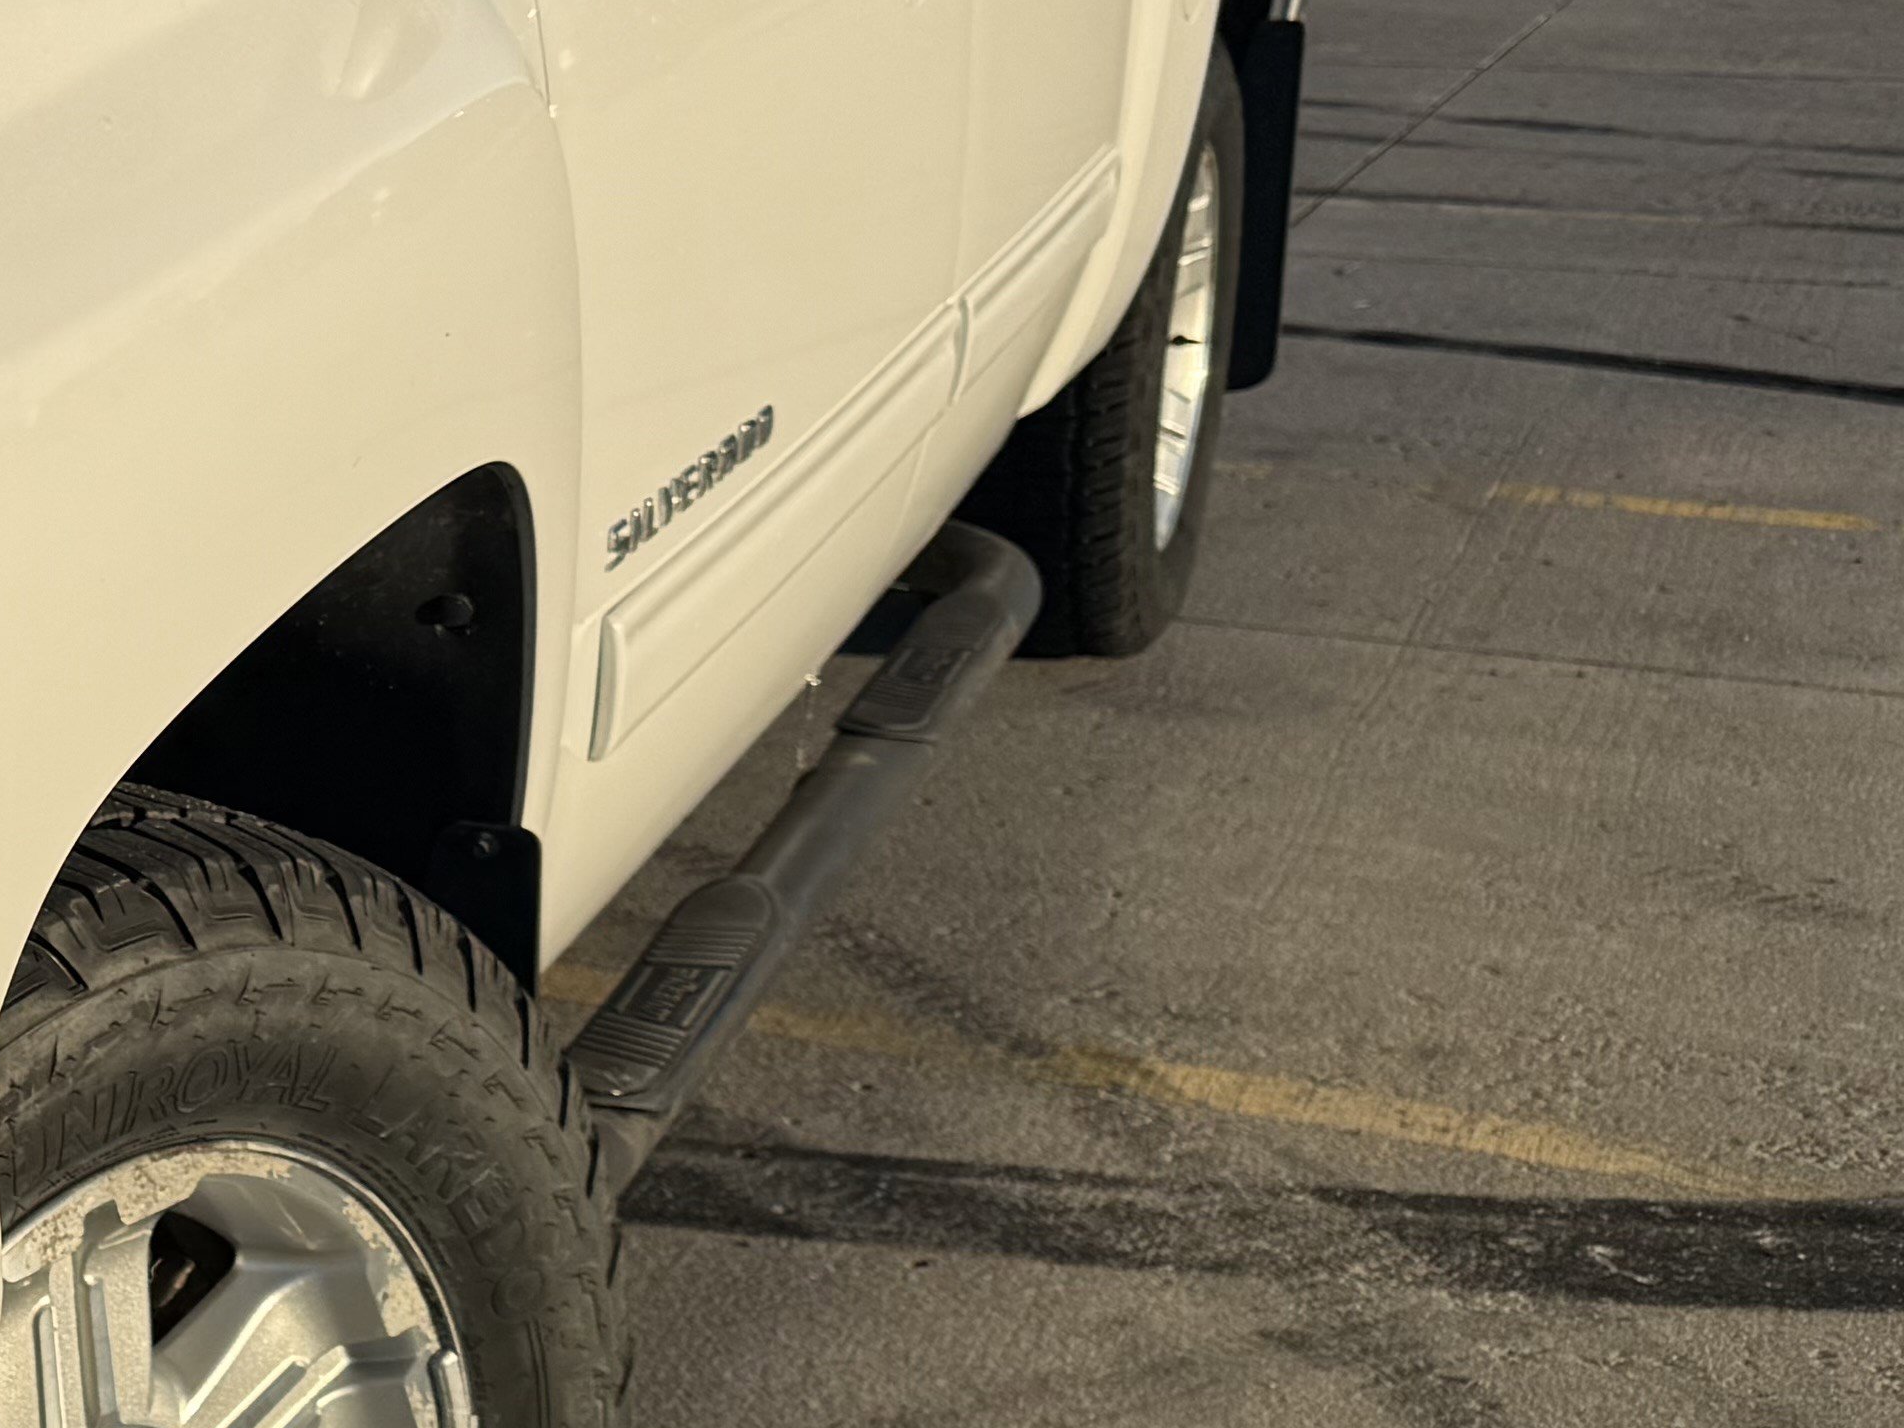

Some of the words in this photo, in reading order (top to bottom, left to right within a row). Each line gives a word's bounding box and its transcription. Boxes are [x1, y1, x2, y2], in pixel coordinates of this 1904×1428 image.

[604, 404, 774, 573] SILVERADO
[5, 1038, 338, 1190] UNIROYAL
[342, 1062, 547, 1319] LAREDO
